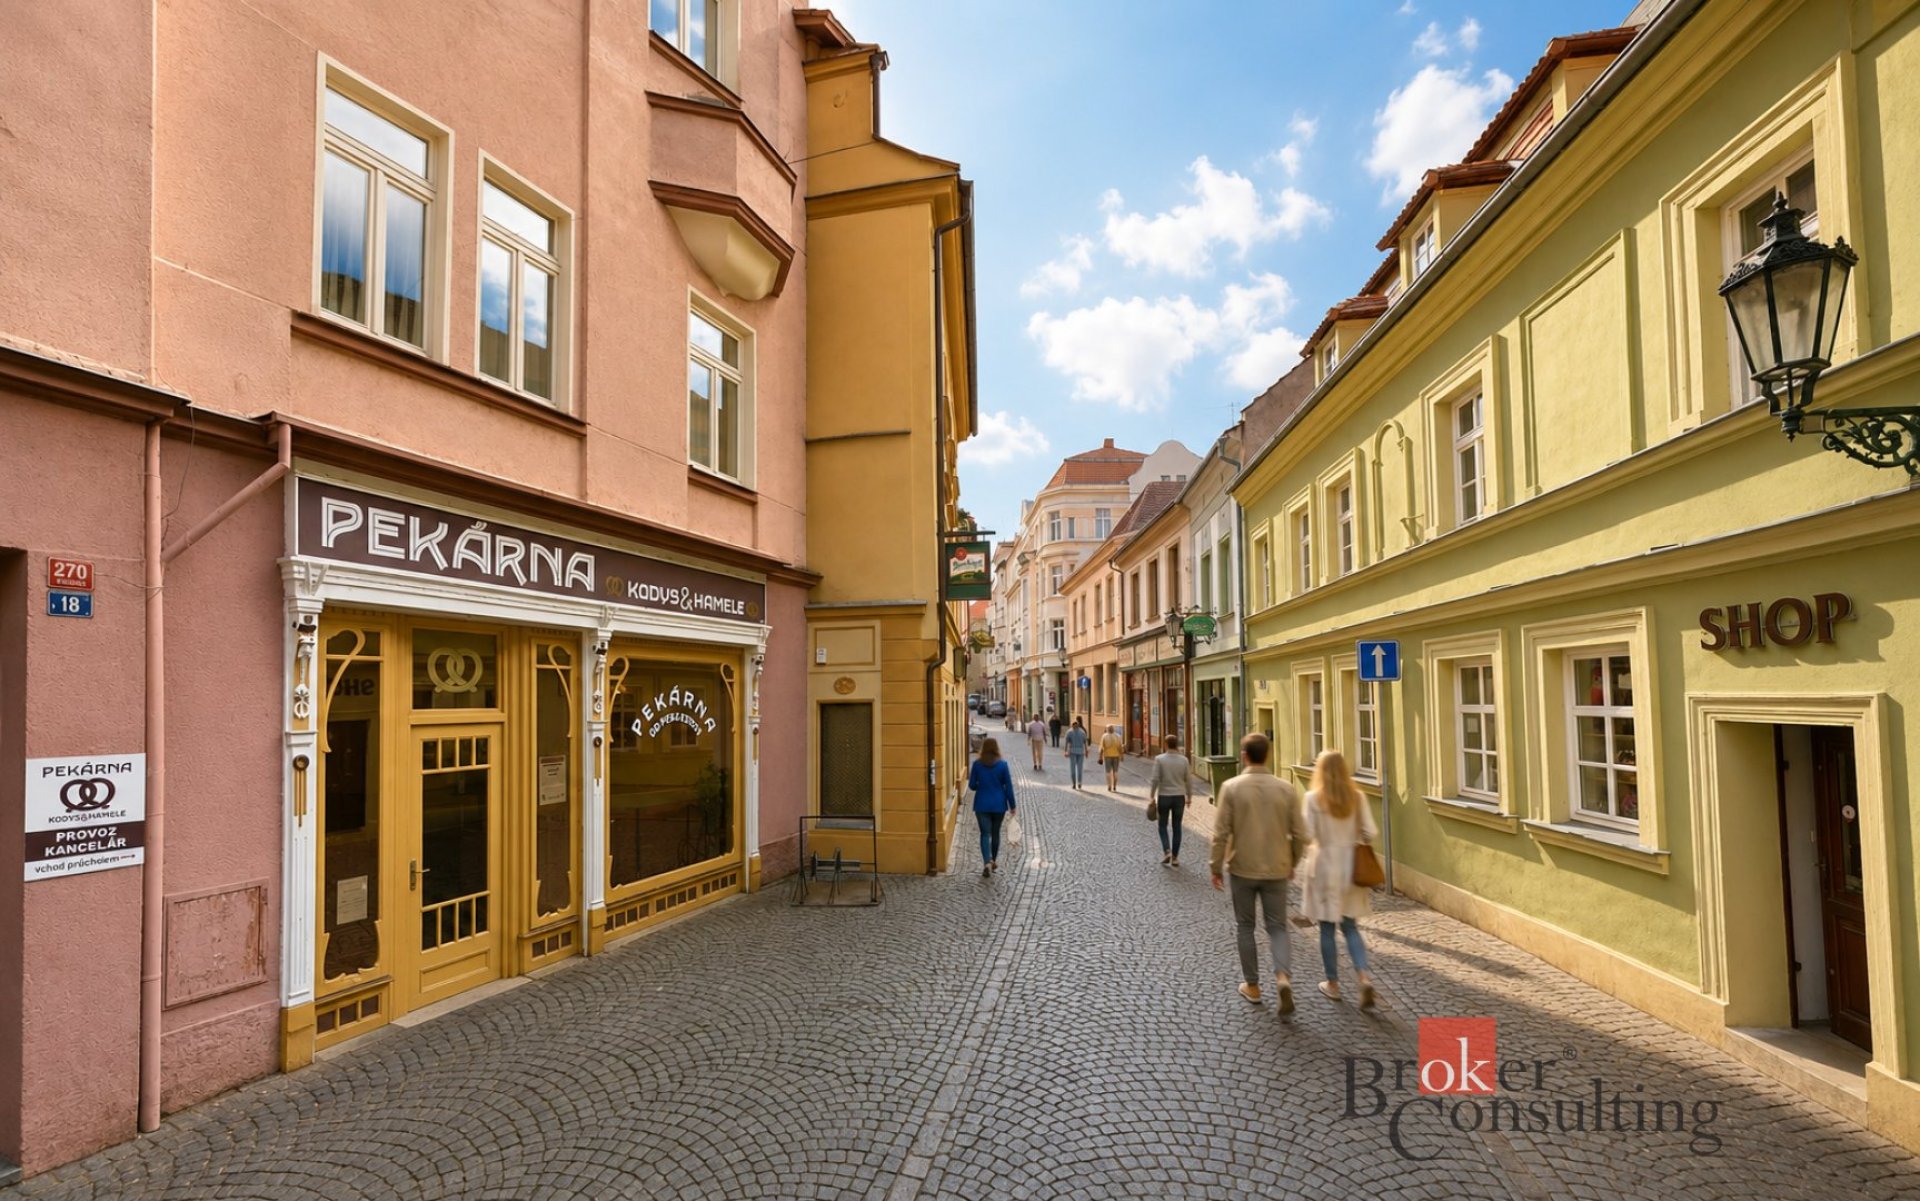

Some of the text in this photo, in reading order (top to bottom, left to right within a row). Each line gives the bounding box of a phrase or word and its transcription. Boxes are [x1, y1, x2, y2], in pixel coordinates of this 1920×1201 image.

[321, 496, 596, 592] PEKÁRNA
[54, 562, 87, 579] 270
[61, 596, 80, 613] 18
[1699, 592, 1853, 651] SHOP
[631, 685, 716, 736] PEKÁRNA
[42, 762, 132, 778] PEKÁRNA
[56, 826, 117, 842] PROVOZ
[35, 862, 66, 873] vchod
